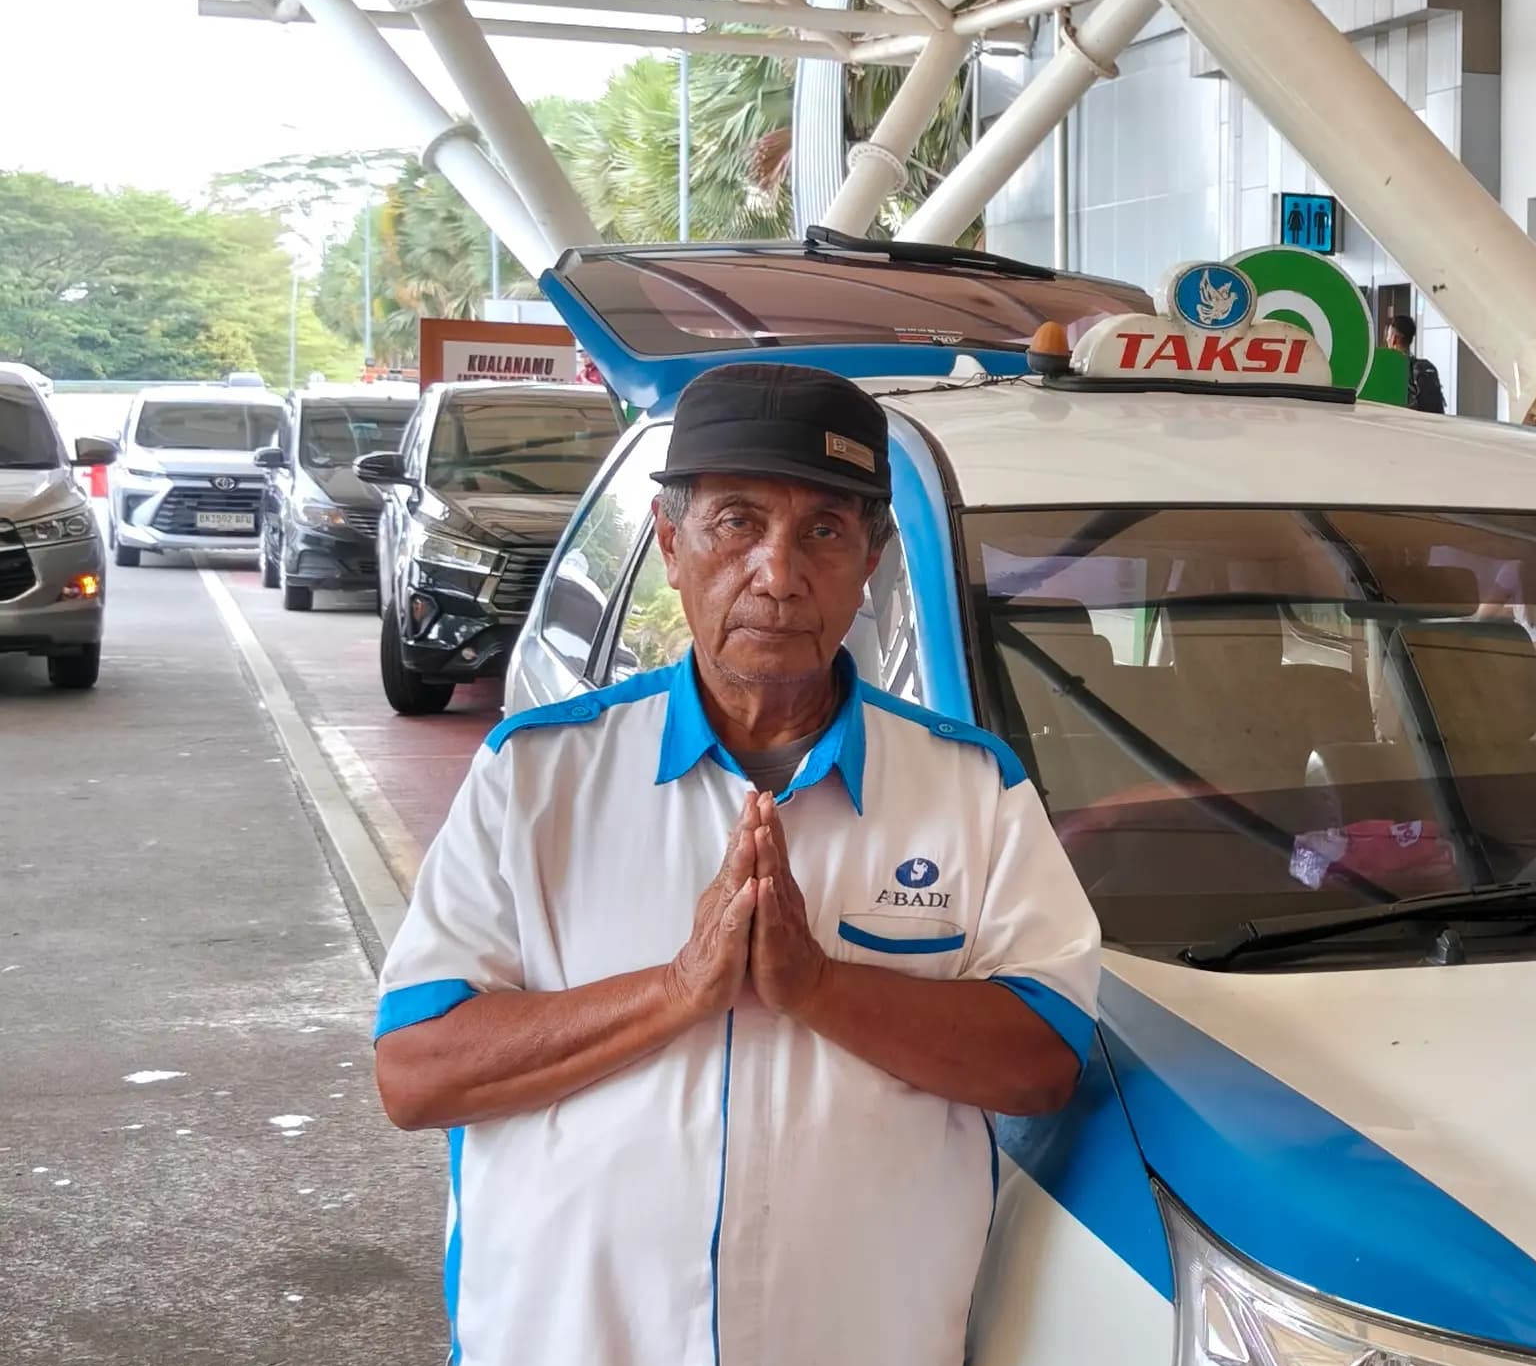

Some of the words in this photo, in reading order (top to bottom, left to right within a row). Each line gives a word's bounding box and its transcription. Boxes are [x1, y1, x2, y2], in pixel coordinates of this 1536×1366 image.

[1116, 333, 1308, 374] TAKSI
[467, 354, 555, 375] KUALANAMU
[875, 889, 952, 909] ABADI
